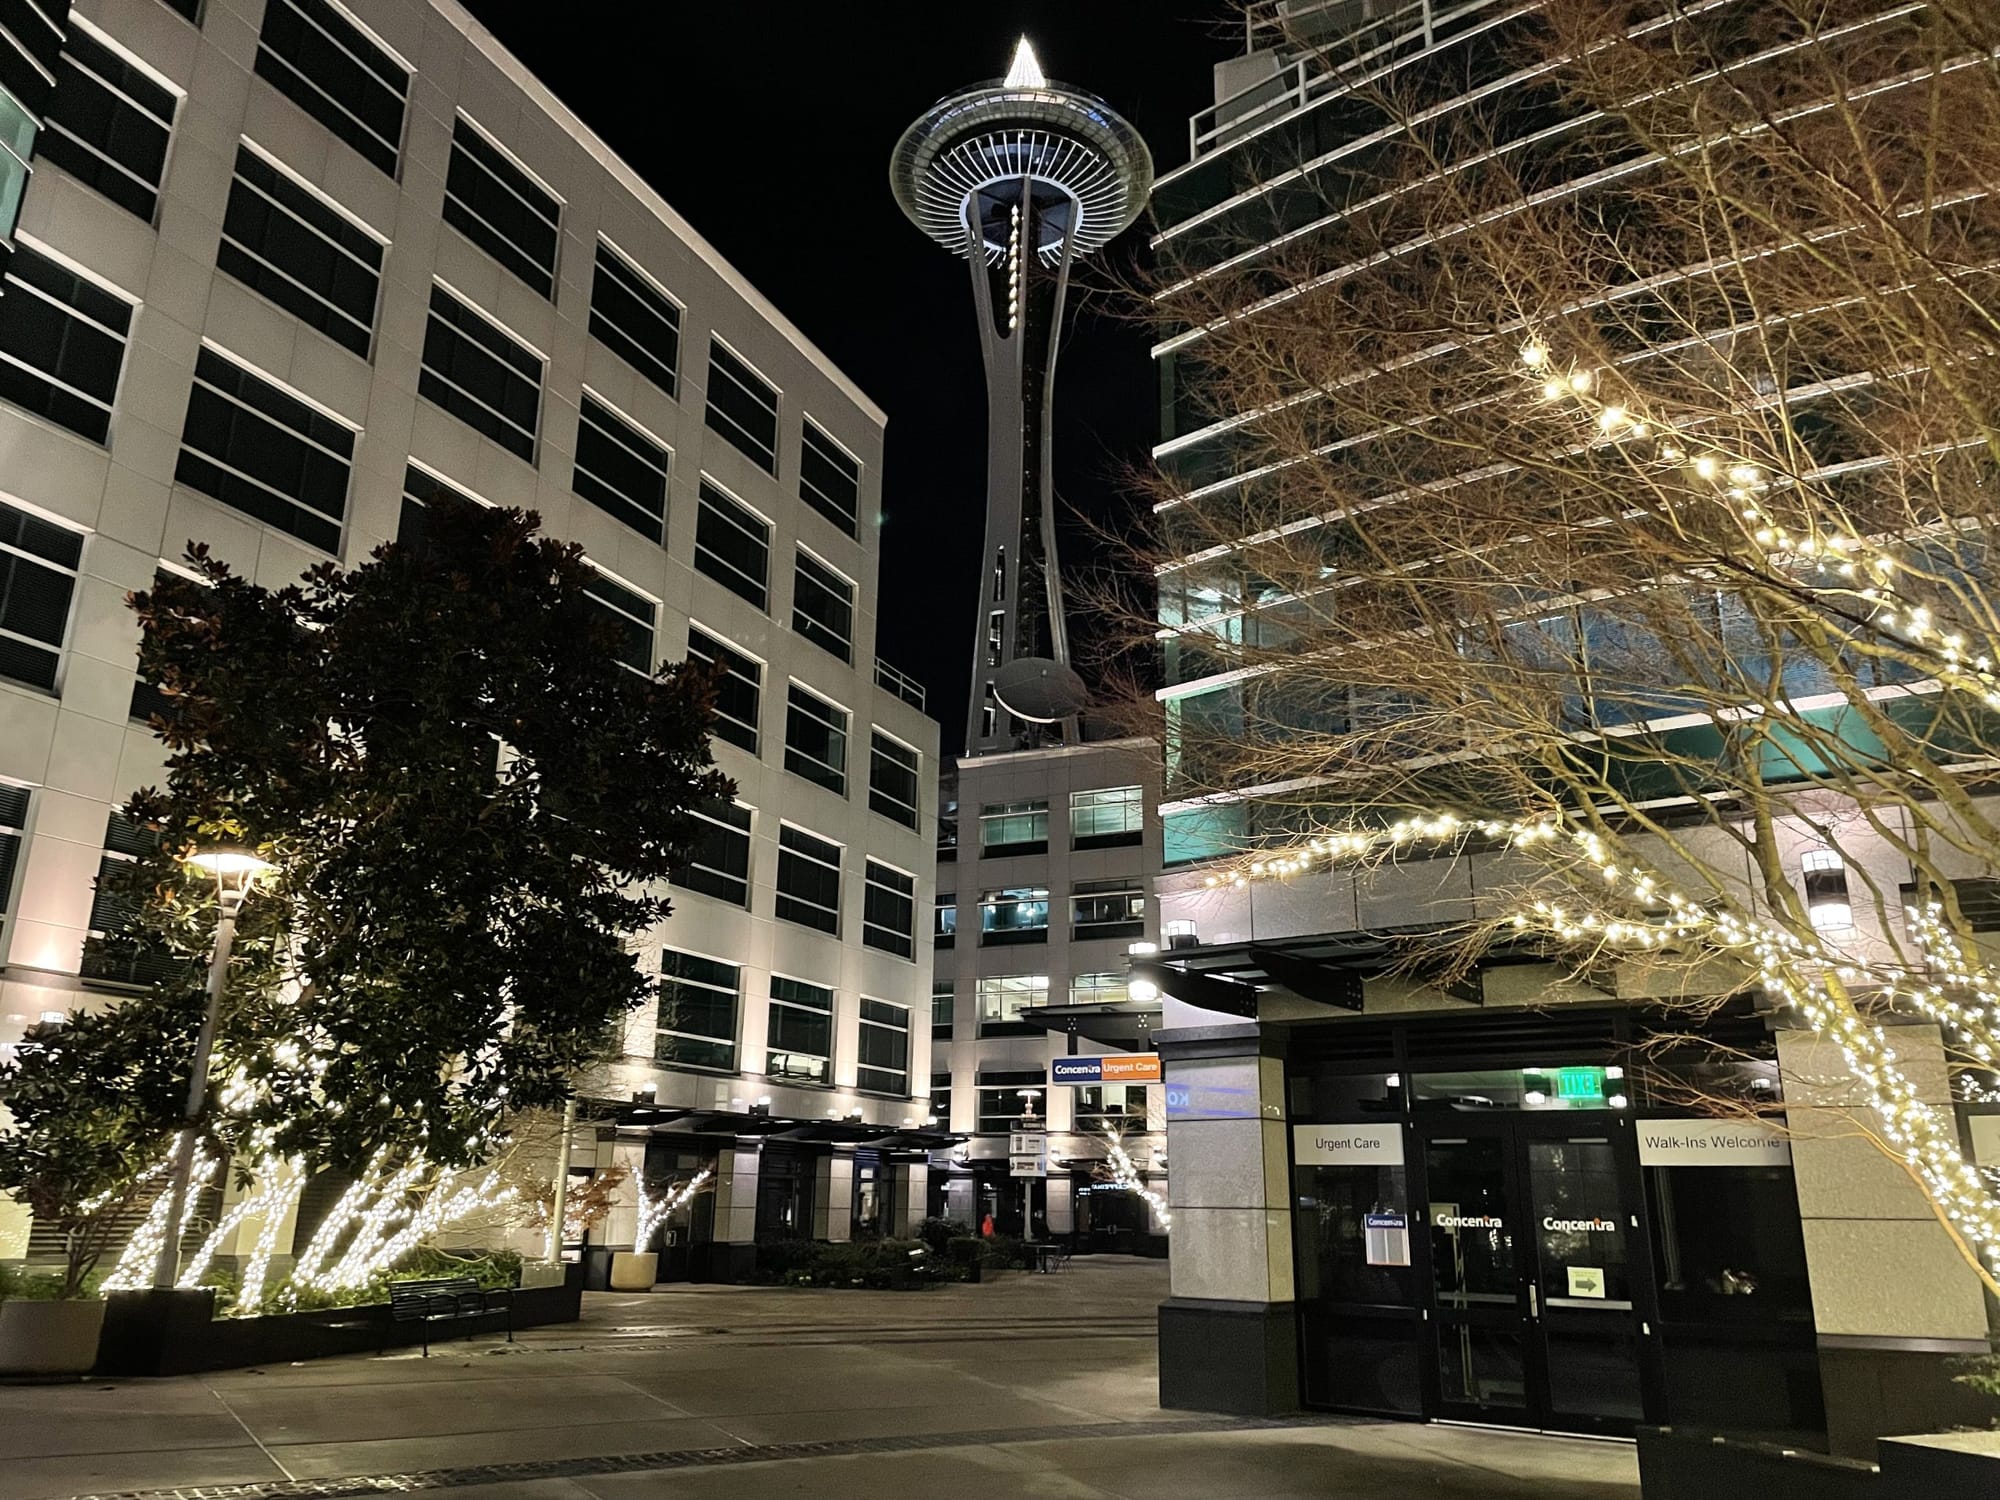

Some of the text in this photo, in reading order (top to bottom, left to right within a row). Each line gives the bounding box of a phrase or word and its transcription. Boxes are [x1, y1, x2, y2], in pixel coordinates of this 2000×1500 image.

[1055, 1062, 1157, 1075] Concentra Urgent Care
[1315, 1137, 1381, 1151] Urgent Care
[1645, 1136, 1780, 1149] Walk-Ins Welcome
[1368, 1217, 1404, 1227] Concentra
[1436, 1213, 1503, 1228] Concentra
[1543, 1216, 1616, 1232] Concentra
